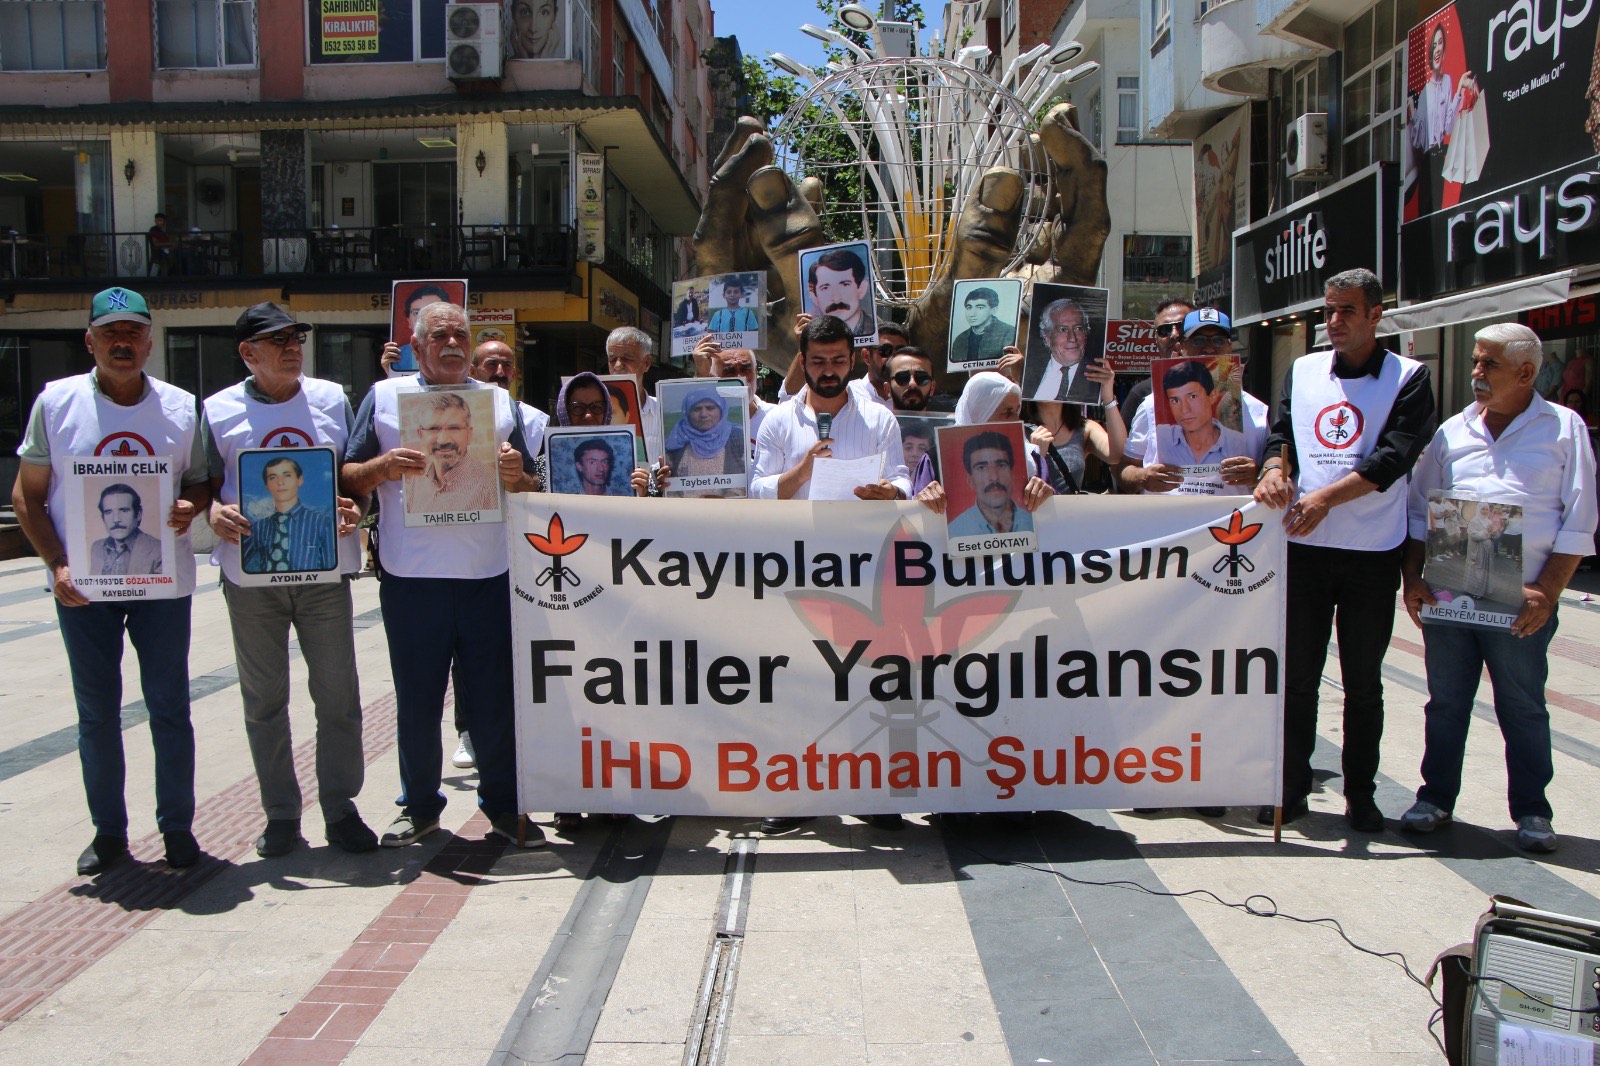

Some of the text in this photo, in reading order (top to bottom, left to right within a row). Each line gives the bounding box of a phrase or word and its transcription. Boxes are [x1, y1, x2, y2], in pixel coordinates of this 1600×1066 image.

[324, 39, 377, 52] 0532 553 58 85
[1520, 84, 1530, 96] de
[1530, 73, 1550, 91] Mutlu
[1447, 173, 1594, 263] rays
[1264, 212, 1327, 284] stilife
[470, 313, 513, 322] SOFRASI
[1116, 324, 1158, 343] Şiri
[962, 360, 984, 369] ÇETİN
[73, 460, 168, 476] İBRAHİM ÇELİK
[680, 477, 732, 489] Taybet Ana
[423, 510, 480, 524] TAHİR ELÇİ
[957, 537, 1029, 552] Eset GÖKTAYI
[610, 538, 1190, 600] Kayıplar Bulunsun
[125, 576, 173, 585] GÖZALTINDA
[270, 573, 319, 583] AYDIN AY
[1190, 569, 1276, 595] İNSAN HAKLARI DERNEĞİ
[1225, 579, 1242, 587] 1986
[102, 588, 147, 597] KAYBEDİLDİ
[537, 599, 570, 611] HAKLARI
[572, 583, 605, 609] DERNEĞİ
[549, 593, 567, 602] 1986
[1428, 606, 1515, 625] MERYEM BULUT
[530, 635, 1279, 718] Failler Yargılansın
[581, 727, 1202, 799] İHD Batman Şubesi
[1518, 1003, 1546, 1014] SH-667
